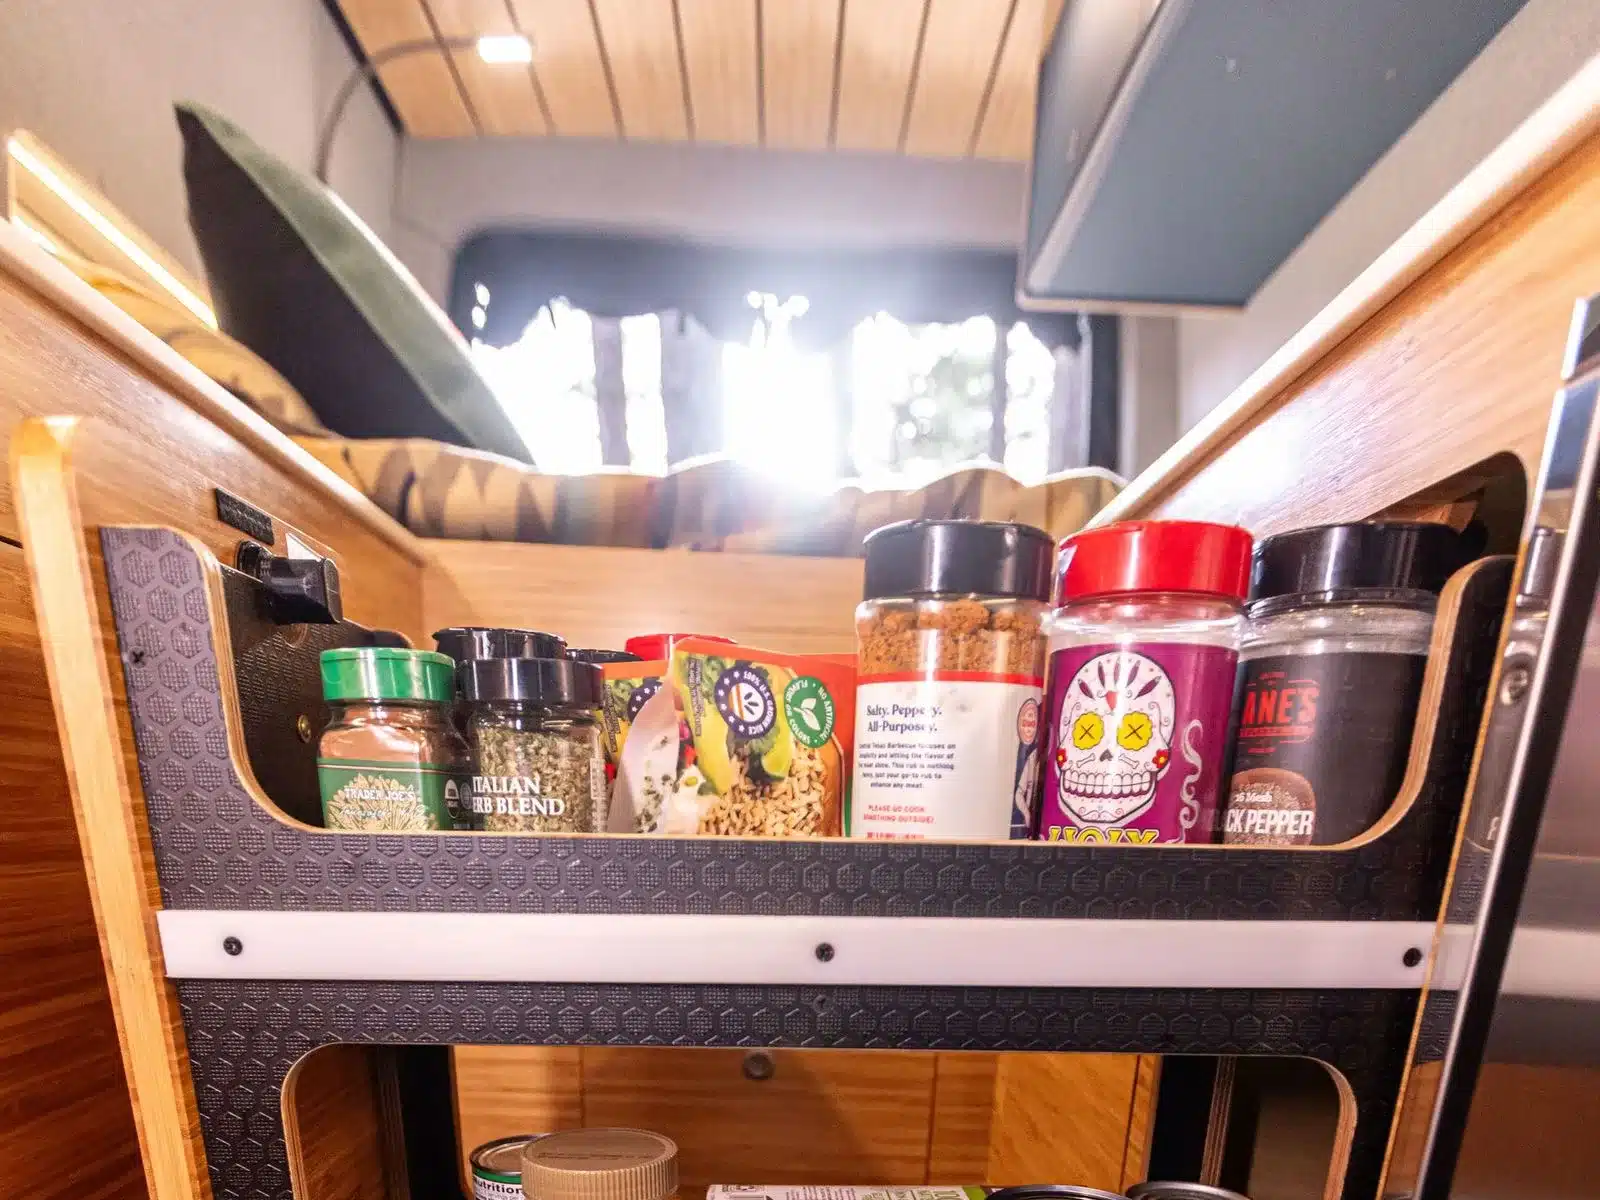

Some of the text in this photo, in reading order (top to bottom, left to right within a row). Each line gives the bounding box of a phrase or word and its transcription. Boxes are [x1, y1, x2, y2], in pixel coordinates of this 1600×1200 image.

[1241, 686, 1319, 725] ANE'S
[472, 796, 565, 816] ERB BLEND
[1245, 809, 1314, 835] PEPPER
[475, 1178, 522, 1194] utrition
